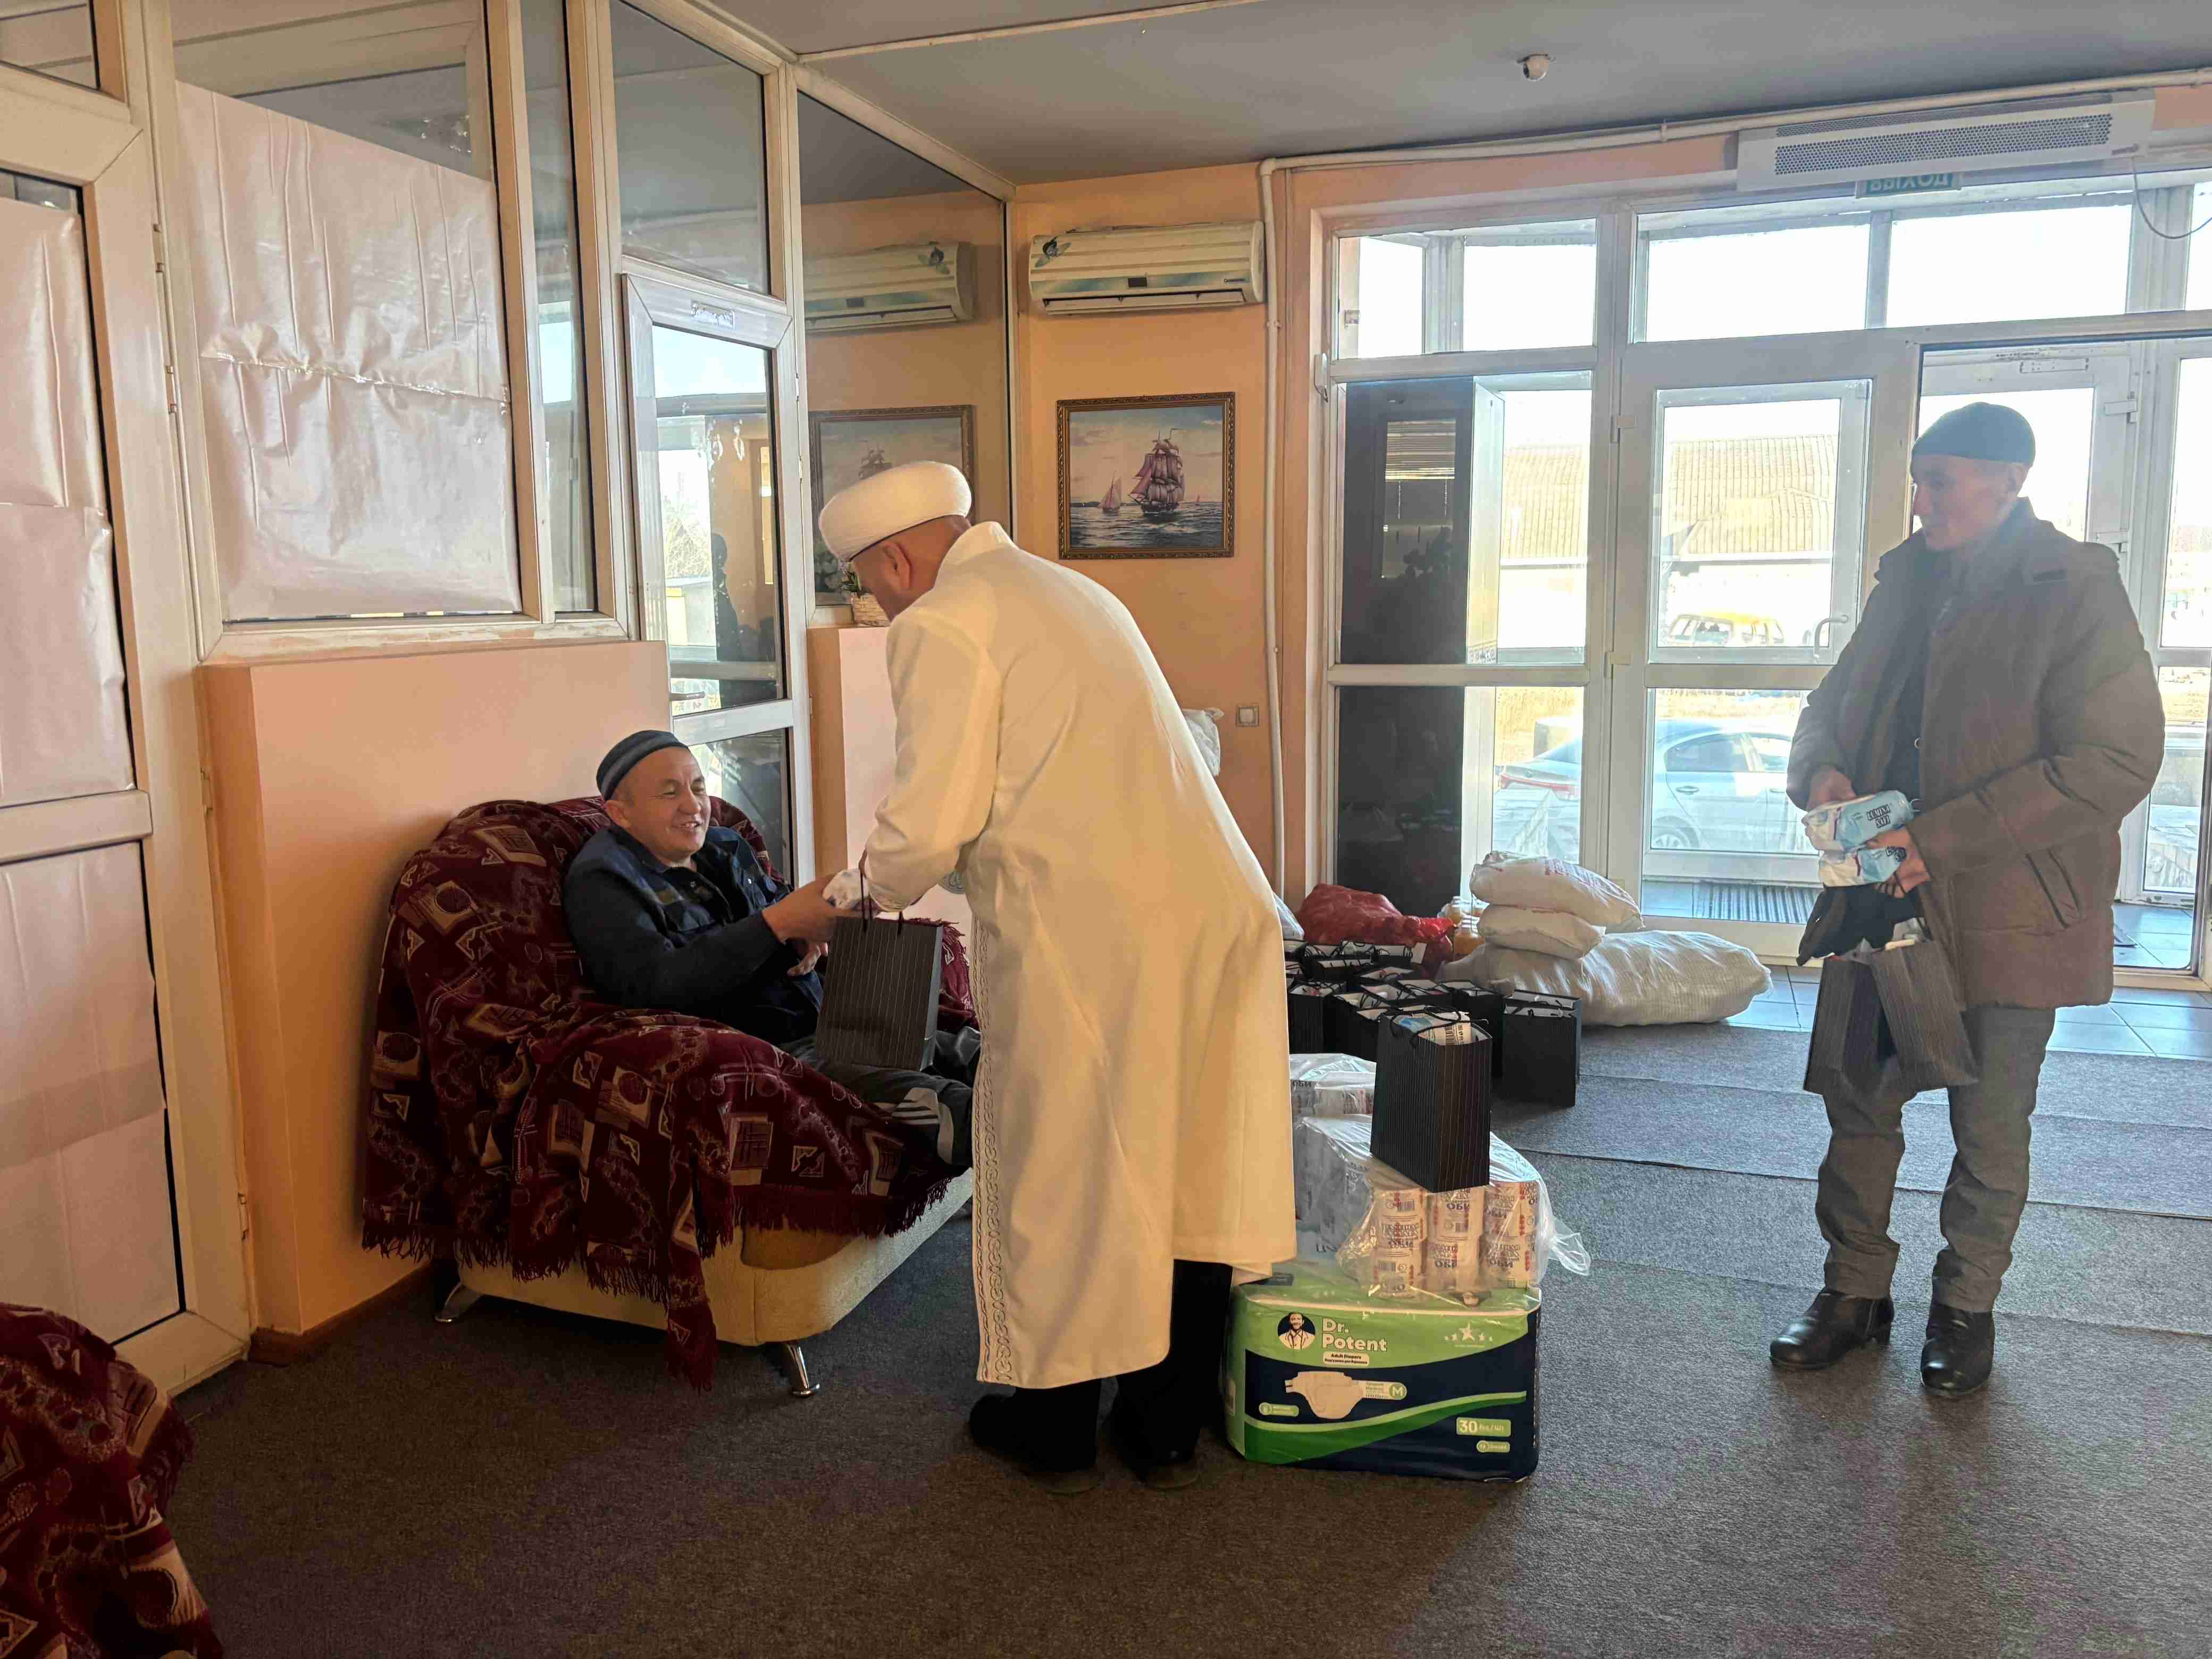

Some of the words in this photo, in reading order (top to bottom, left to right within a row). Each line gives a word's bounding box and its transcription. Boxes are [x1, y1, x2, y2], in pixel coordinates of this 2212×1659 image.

[1322, 1318, 1349, 1333] Dr.
[1321, 1334, 1387, 1352] Potent
[1392, 1386, 1403, 1396] M
[1459, 1420, 1478, 1433] 30
